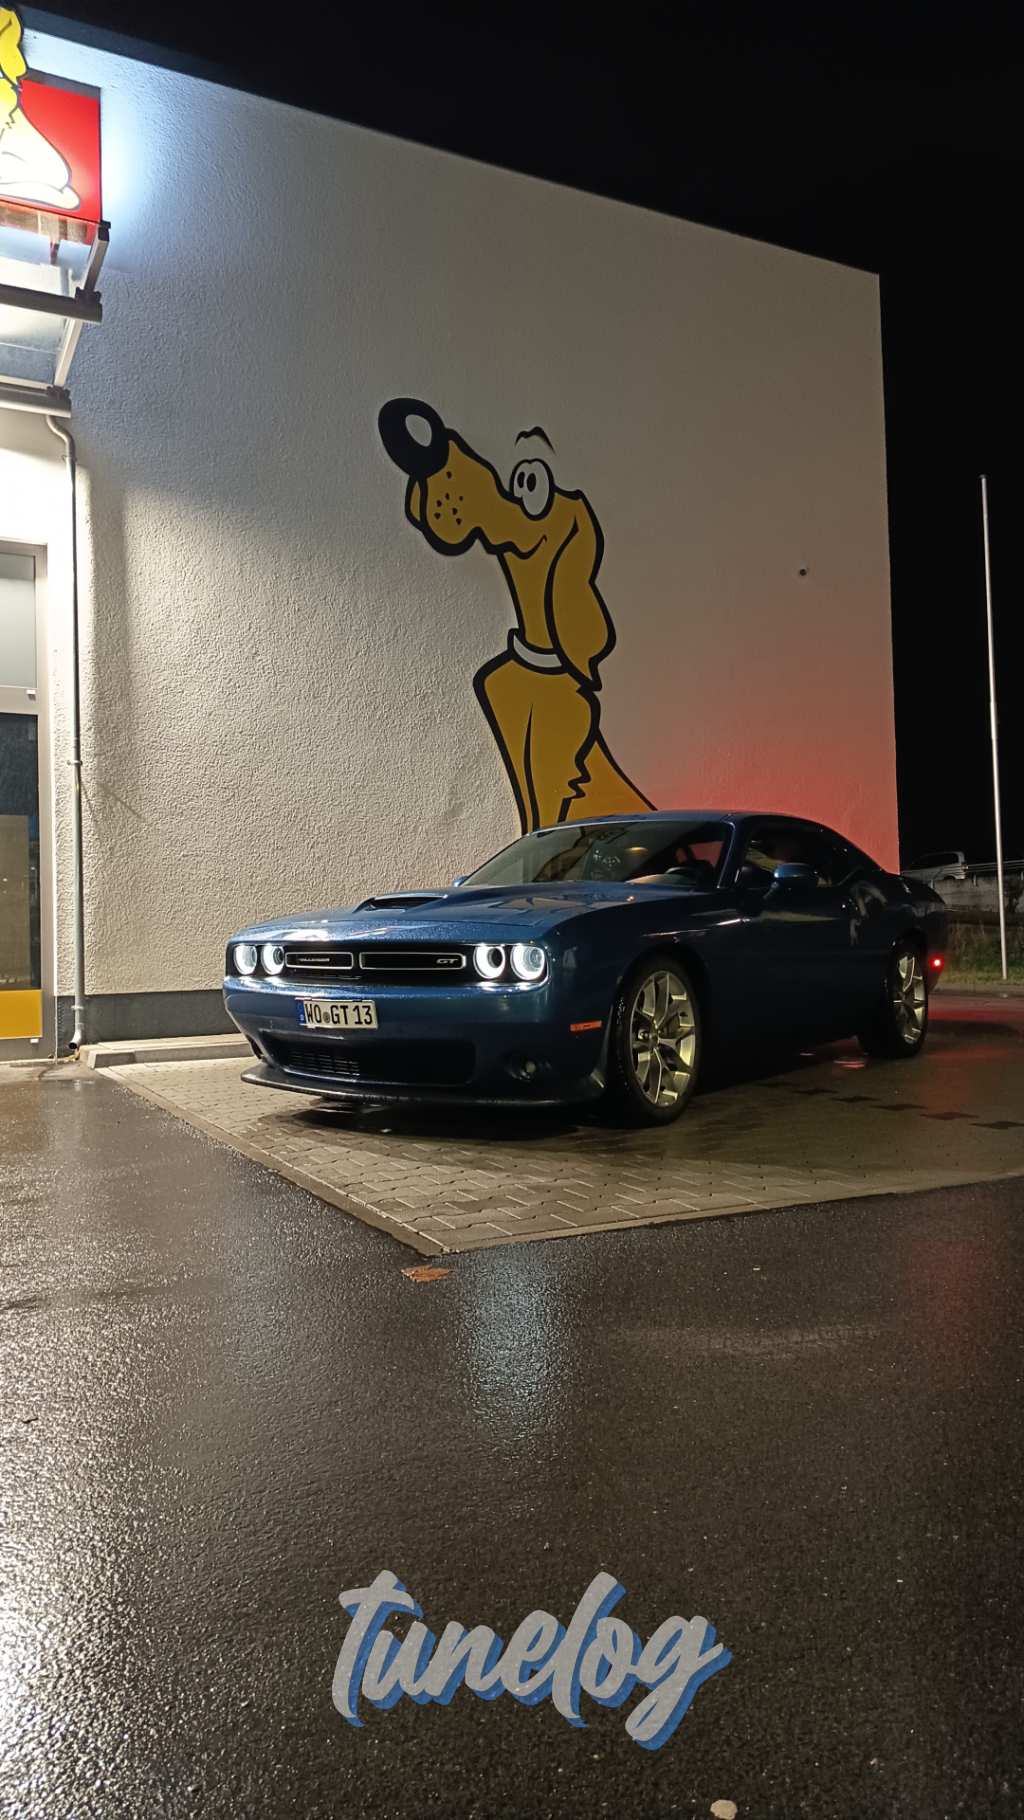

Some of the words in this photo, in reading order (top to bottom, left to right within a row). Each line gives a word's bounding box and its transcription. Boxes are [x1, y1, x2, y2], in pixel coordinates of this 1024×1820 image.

[304, 1003, 322, 1024] WO
[330, 1004, 349, 1025] GT
[353, 1004, 373, 1025] 13
